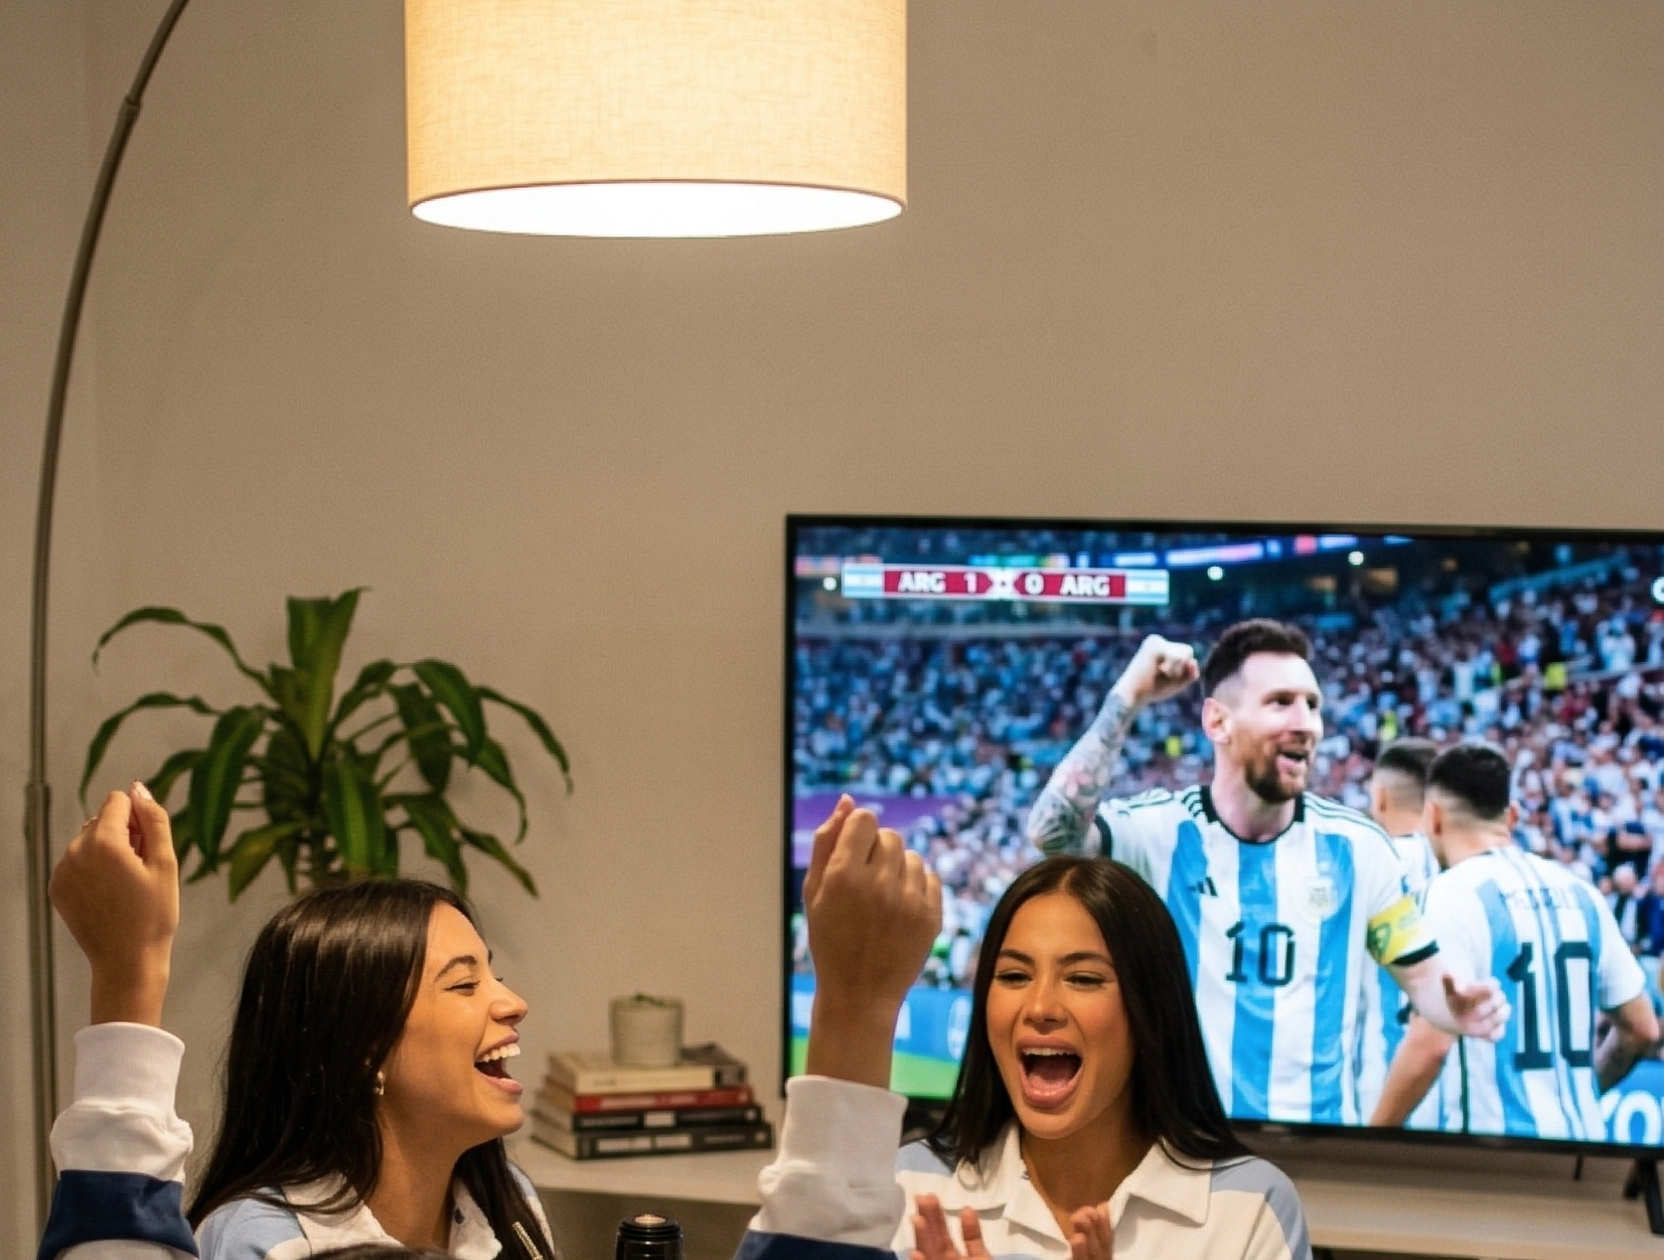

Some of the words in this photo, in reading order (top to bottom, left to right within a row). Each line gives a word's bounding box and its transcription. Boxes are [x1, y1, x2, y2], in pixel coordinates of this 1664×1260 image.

[898, 572, 946, 593] ARG
[963, 572, 978, 594] 1
[1024, 573, 1045, 595] 0
[1060, 574, 1110, 597] ARG
[1225, 921, 1296, 987] 10
[1506, 941, 1594, 1071] 10
